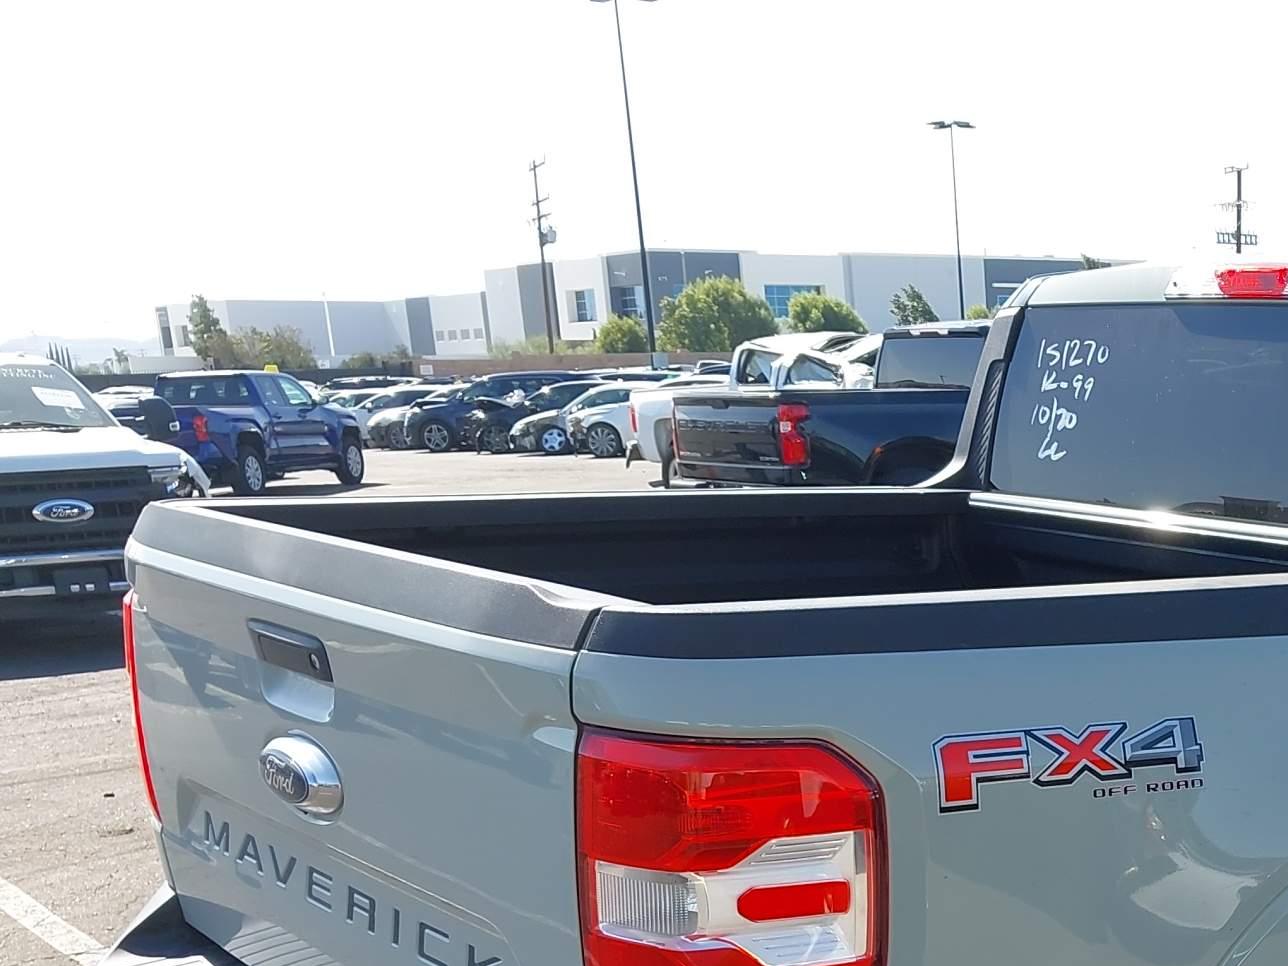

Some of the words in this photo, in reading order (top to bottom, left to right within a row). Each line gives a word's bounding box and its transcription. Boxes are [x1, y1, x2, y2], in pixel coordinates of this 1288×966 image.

[49, 503, 80, 518] Ford
[264, 754, 296, 796] Ford
[932, 715, 1205, 816] FX4
[1093, 784, 1137, 799] OFF
[1145, 777, 1205, 793] ROAD
